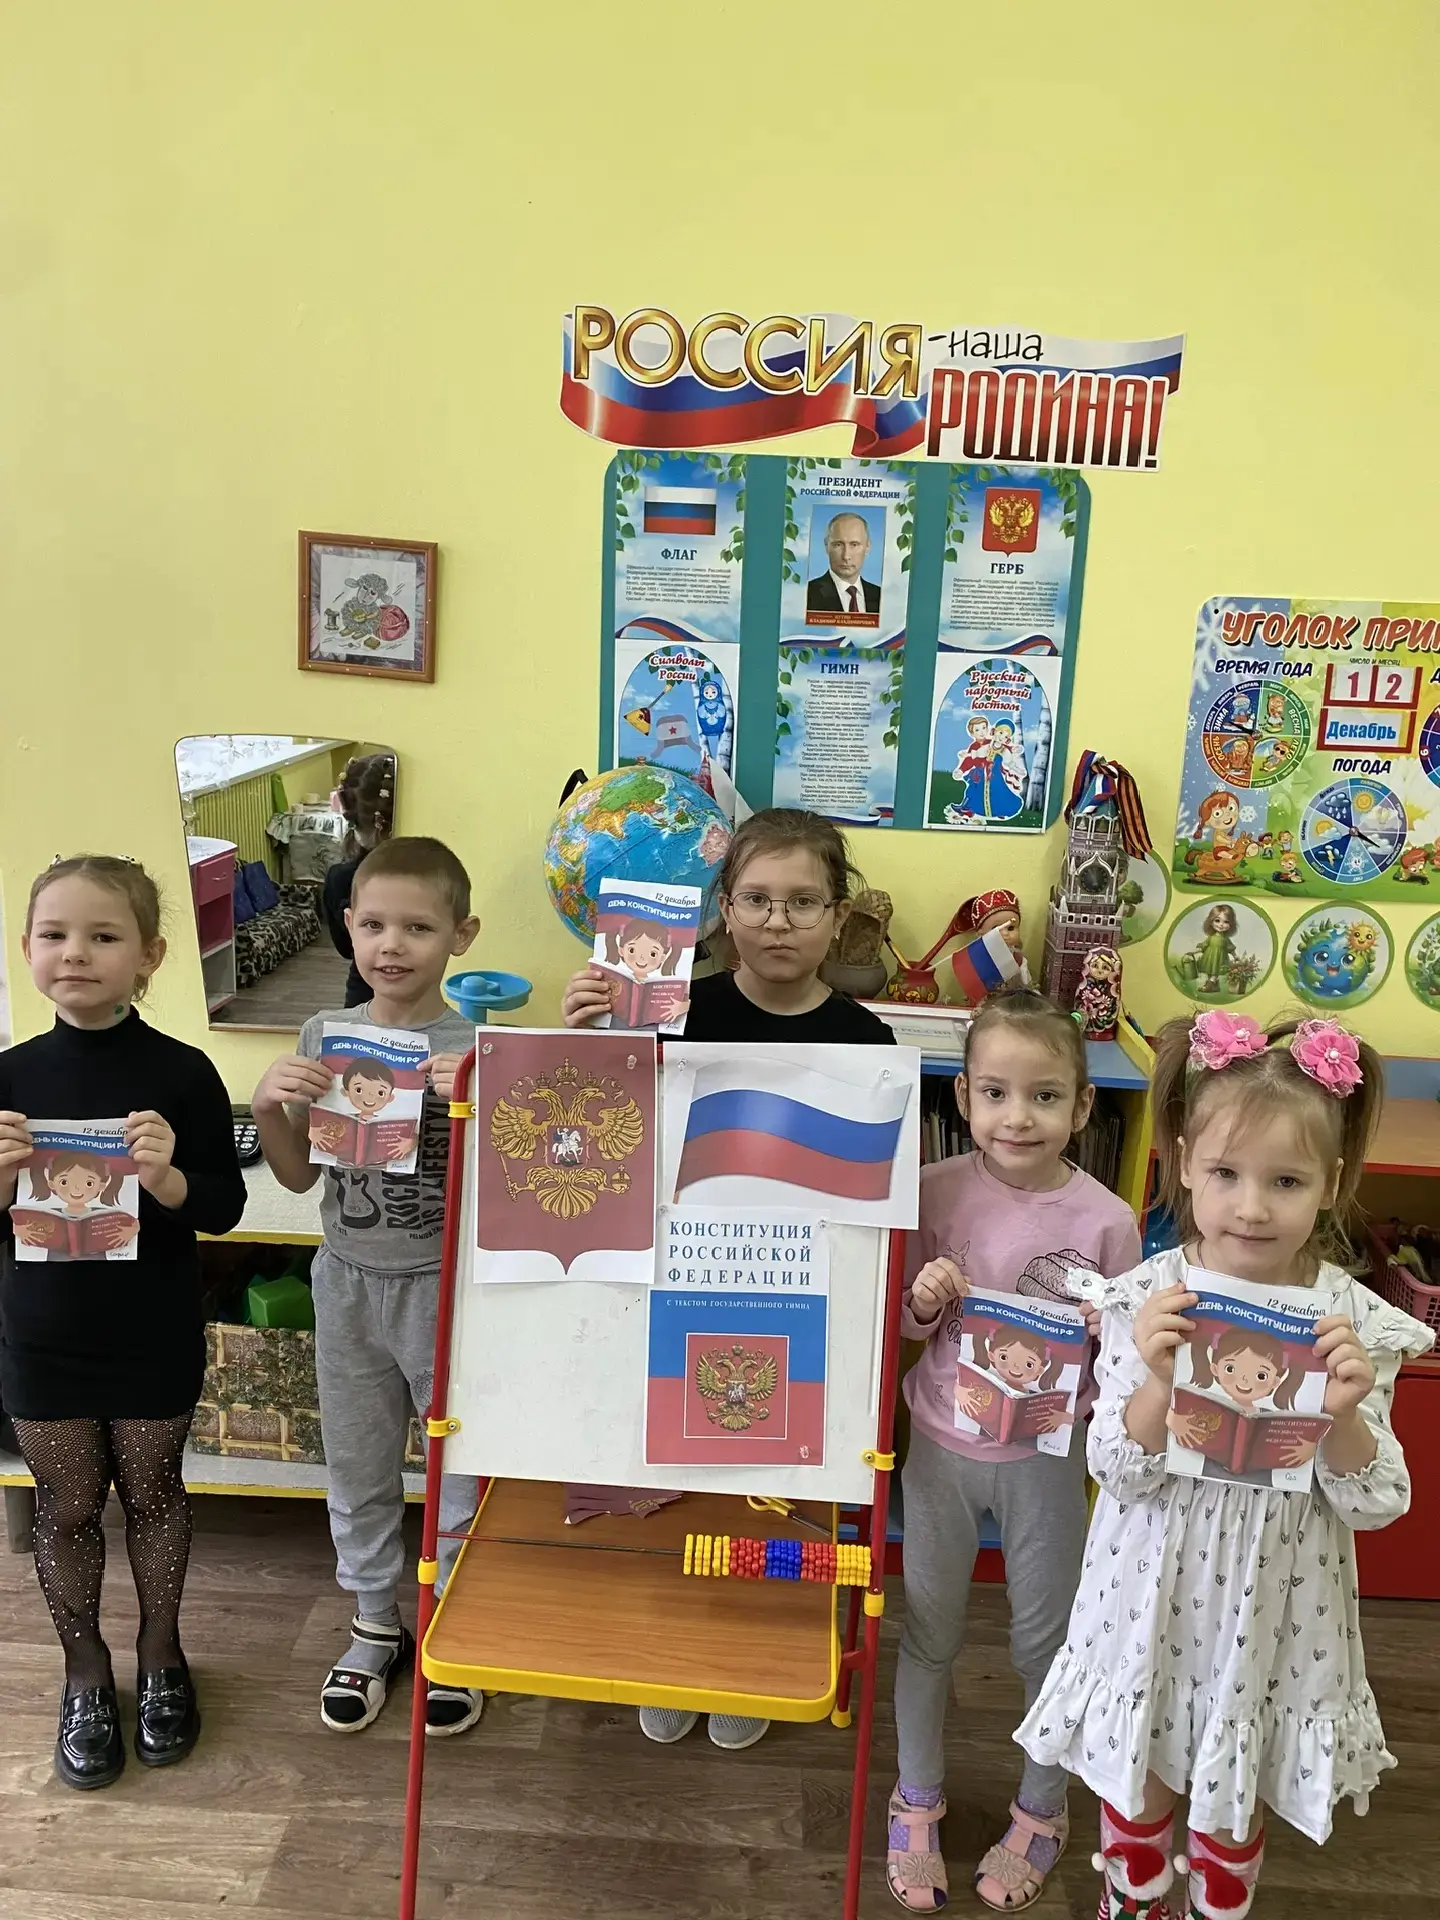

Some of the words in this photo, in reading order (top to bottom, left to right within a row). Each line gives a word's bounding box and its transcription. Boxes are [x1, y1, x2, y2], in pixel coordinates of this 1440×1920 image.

[572, 304, 923, 398] РОССИЯ
[927, 368, 1169, 467] РОДИНА!
[818, 477, 882, 488] ПРЕЗИДЕНТ
[800, 488, 851, 497] РОССИЙСКОЙ
[852, 490, 900, 499] ФЕДЕРАЦИИ
[661, 549, 697, 560] ФЛАГ
[990, 563, 1024, 574] ГЕРБ
[1222, 612, 1358, 648] УГОЛОК
[650, 654, 705, 667] Символы
[820, 663, 860, 674] ГИМН
[1214, 660, 1268, 675] ВРЕМЯ
[1274, 662, 1313, 677] ГОДА
[659, 670, 696, 680] России
[971, 670, 1025, 683] Русский
[965, 685, 1030, 699] народный
[1348, 672, 1359, 698] 1
[1385, 673, 1402, 699] 2
[971, 700, 1020, 711] костюм
[1213, 708, 1229, 732] ЗИМА
[1288, 708, 1301, 734] ВЕСНА
[1326, 720, 1397, 741] Декабрь
[1212, 736, 1225, 761] ОСЕНЬ
[1286, 738, 1299, 760] ЛЕТО
[1332, 758, 1392, 774] ПОГОДА
[655, 893, 663, 901] 12
[664, 895, 696, 907] декабря
[607, 899, 626, 908] ДЕНЬ
[627, 901, 679, 920] КОНСТИТУЦИИ
[332, 1042, 351, 1050] ДЕНЬ
[352, 1043, 406, 1063] КОНСТИТУЦИИ
[379, 1036, 388, 1044] 12
[390, 1040, 424, 1051] декабря
[82, 1127, 93, 1135] 12
[94, 1127, 129, 1137] декабр
[52, 1137, 116, 1150] КОНСТИТУЦИИ
[669, 1221, 811, 1240] КОНСТИТУЦИЯ
[669, 1244, 811, 1262] РОССИЙСКОЙ
[668, 1267, 811, 1286] ФЕДЕРАЦИИ
[710, 1300, 783, 1309] ГОСУДАРСТВЕННОГО
[785, 1302, 811, 1310] ГИМНА
[1028, 1304, 1038, 1312] 12
[1040, 1308, 1079, 1324] декабря
[1266, 1298, 1279, 1309] 12
[1280, 1302, 1326, 1317] декабря
[974, 1304, 995, 1313] ДЕНЬ
[996, 1308, 1059, 1335] КОНСТИТУЦИИ
[1060, 1327, 1074, 1336] РФ
[1196, 1301, 1224, 1312] ДЕНЬ
[1225, 1304, 1301, 1335] КОНСТИТУЦИИ
